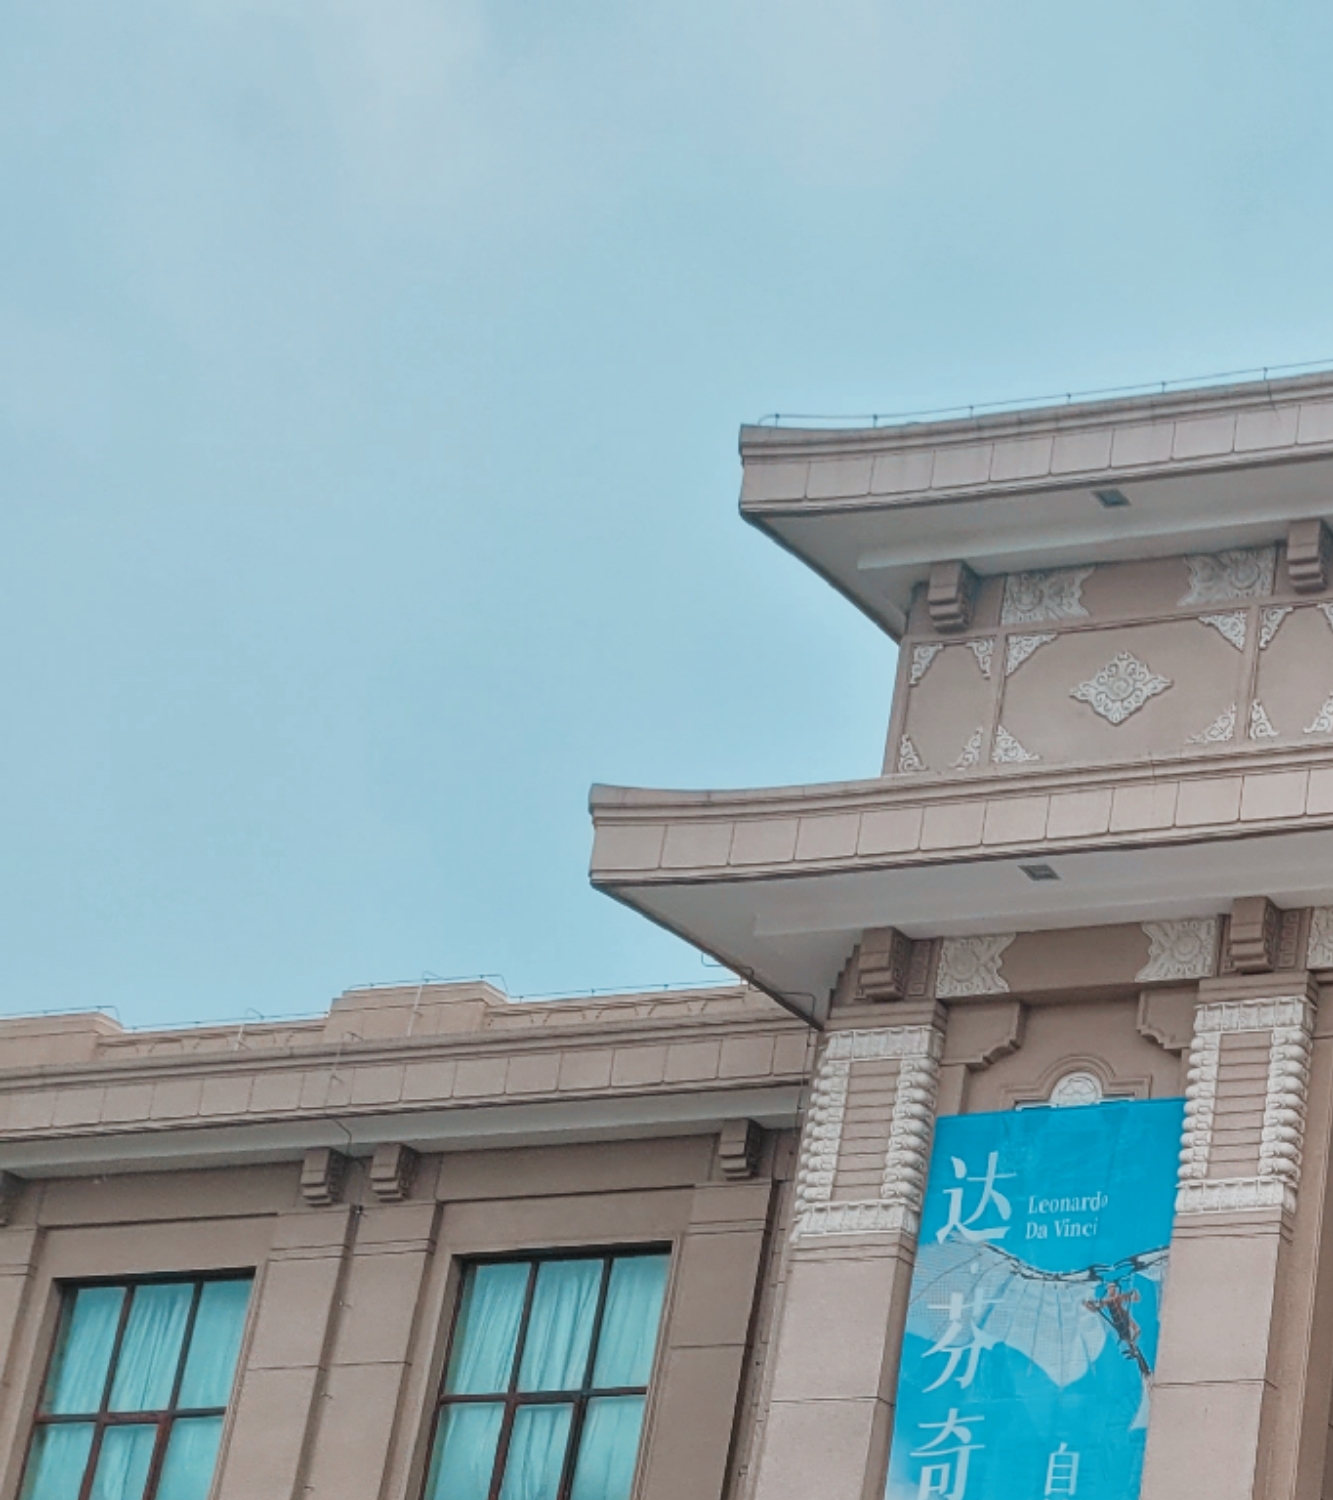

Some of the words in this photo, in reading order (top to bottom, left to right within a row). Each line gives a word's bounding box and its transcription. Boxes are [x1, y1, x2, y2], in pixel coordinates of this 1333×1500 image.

[1028, 1191, 1109, 1214] Leonardo
[1025, 1222, 1048, 1239] Da
[1054, 1218, 1099, 1238] Vinci
